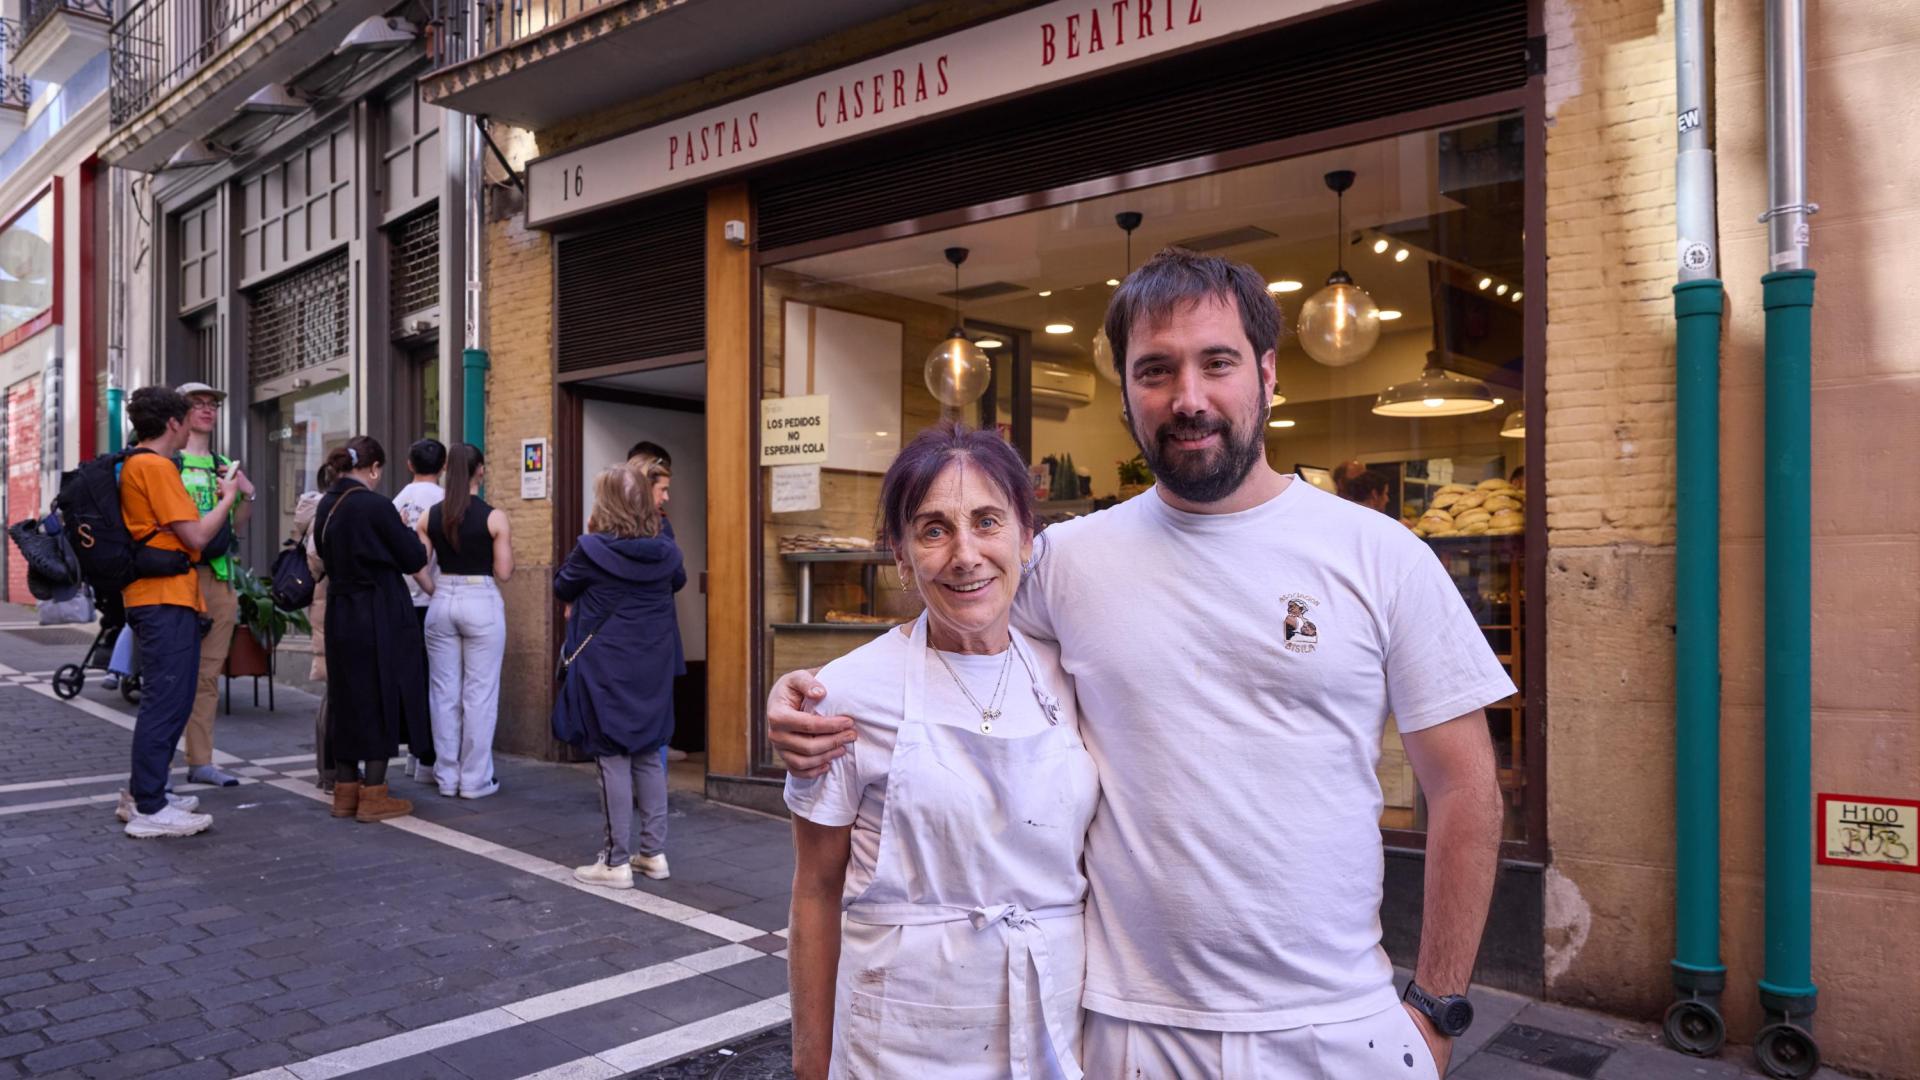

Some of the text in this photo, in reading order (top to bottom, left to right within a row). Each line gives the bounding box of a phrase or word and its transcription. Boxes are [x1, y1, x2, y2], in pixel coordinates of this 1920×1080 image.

[563, 0, 1202, 201] 16 PASTAS CASERAS BEATRIZ
[767, 415, 821, 429] LOS PEDIDOS
[788, 431, 800, 440] NO
[764, 443, 825, 456] ESPERAN COLA
[1842, 804, 1899, 823] H100
